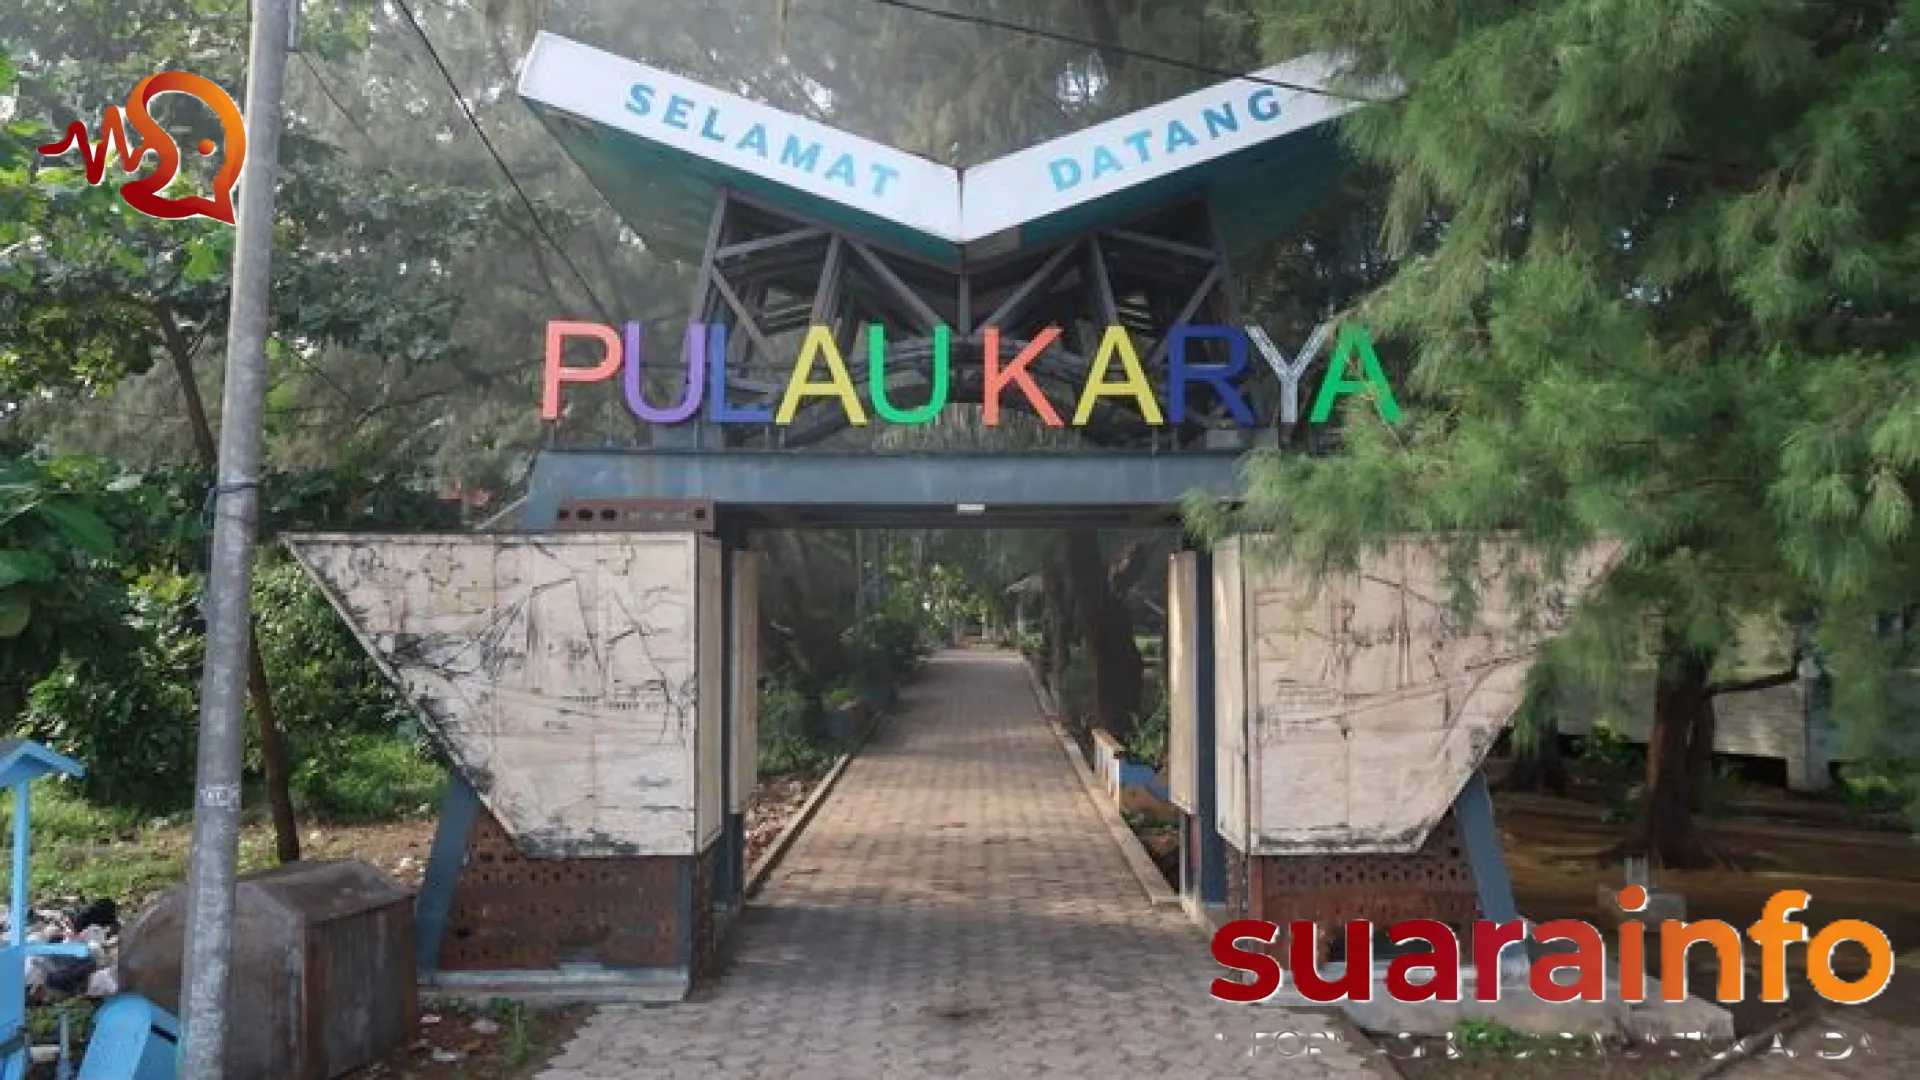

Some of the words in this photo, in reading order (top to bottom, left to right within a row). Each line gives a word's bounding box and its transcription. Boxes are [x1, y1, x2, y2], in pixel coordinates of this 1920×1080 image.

[624, 83, 900, 197] SELAMAT
[1051, 89, 1282, 191] DATANG
[541, 321, 951, 426] PULAU
[982, 324, 1401, 426] KARYA
